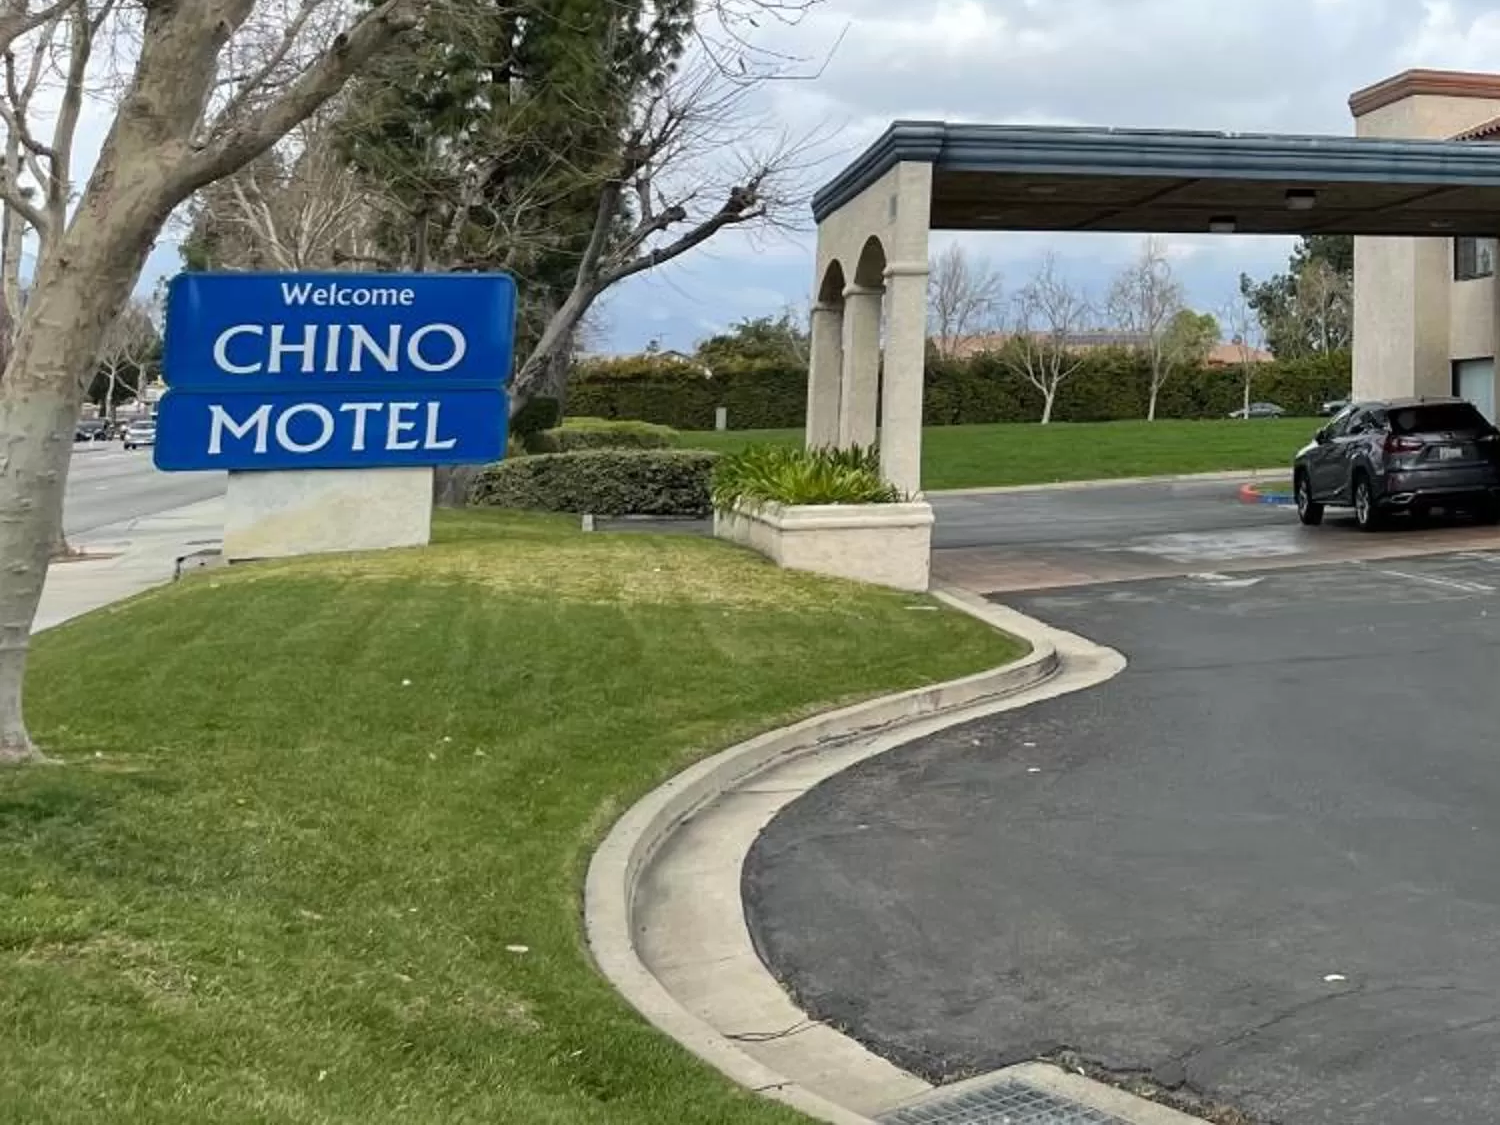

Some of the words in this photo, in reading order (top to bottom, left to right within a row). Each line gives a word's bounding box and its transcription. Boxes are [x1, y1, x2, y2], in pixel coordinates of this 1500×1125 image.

[281, 282, 415, 306] Welcome
[213, 323, 467, 374] CHINO
[207, 401, 457, 455] MOTEL
